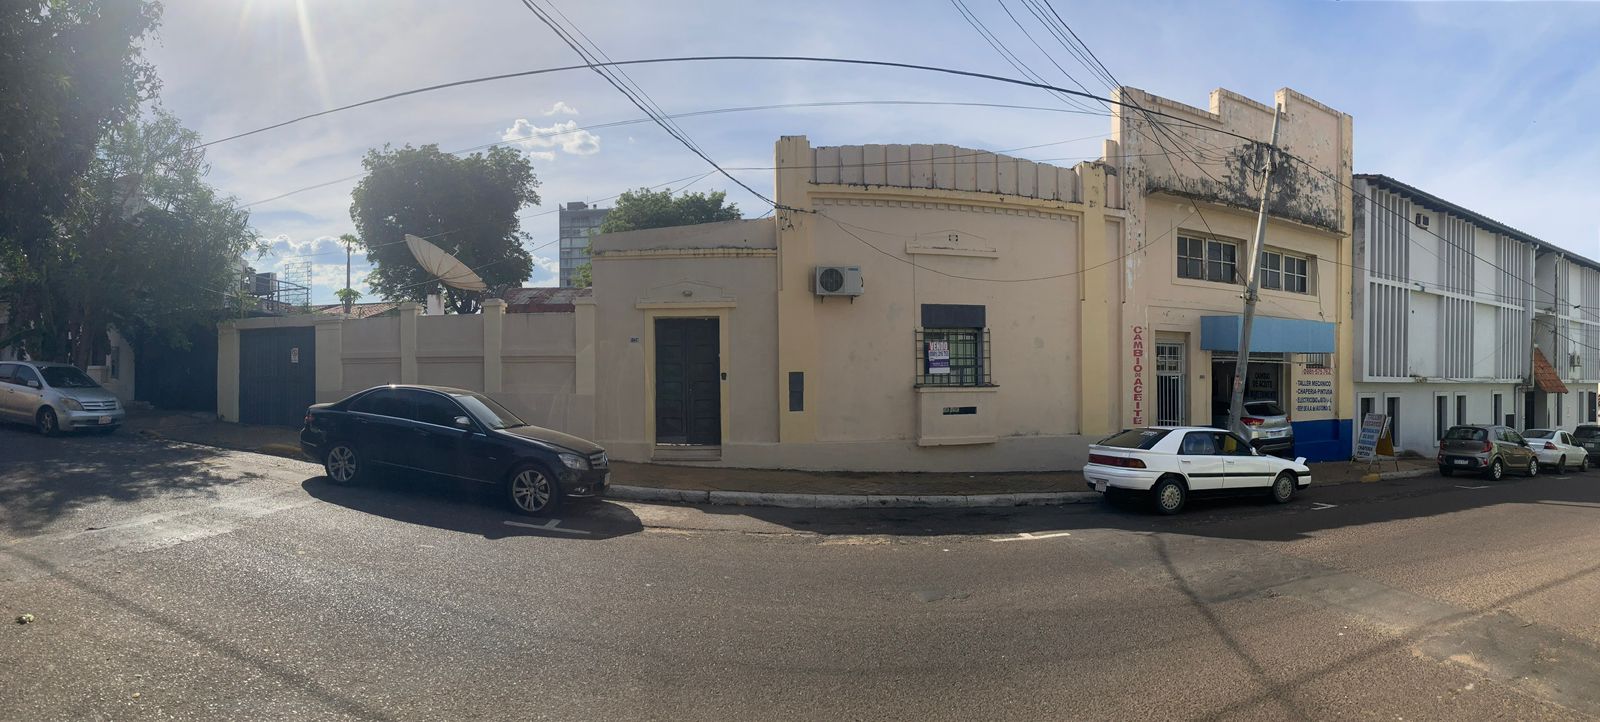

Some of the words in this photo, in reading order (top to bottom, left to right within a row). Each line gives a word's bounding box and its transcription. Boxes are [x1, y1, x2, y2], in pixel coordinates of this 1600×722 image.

[930, 342, 948, 350] VENDO
[1133, 326, 1143, 372] CAMBIO
[1133, 378, 1143, 425] ACEITE
